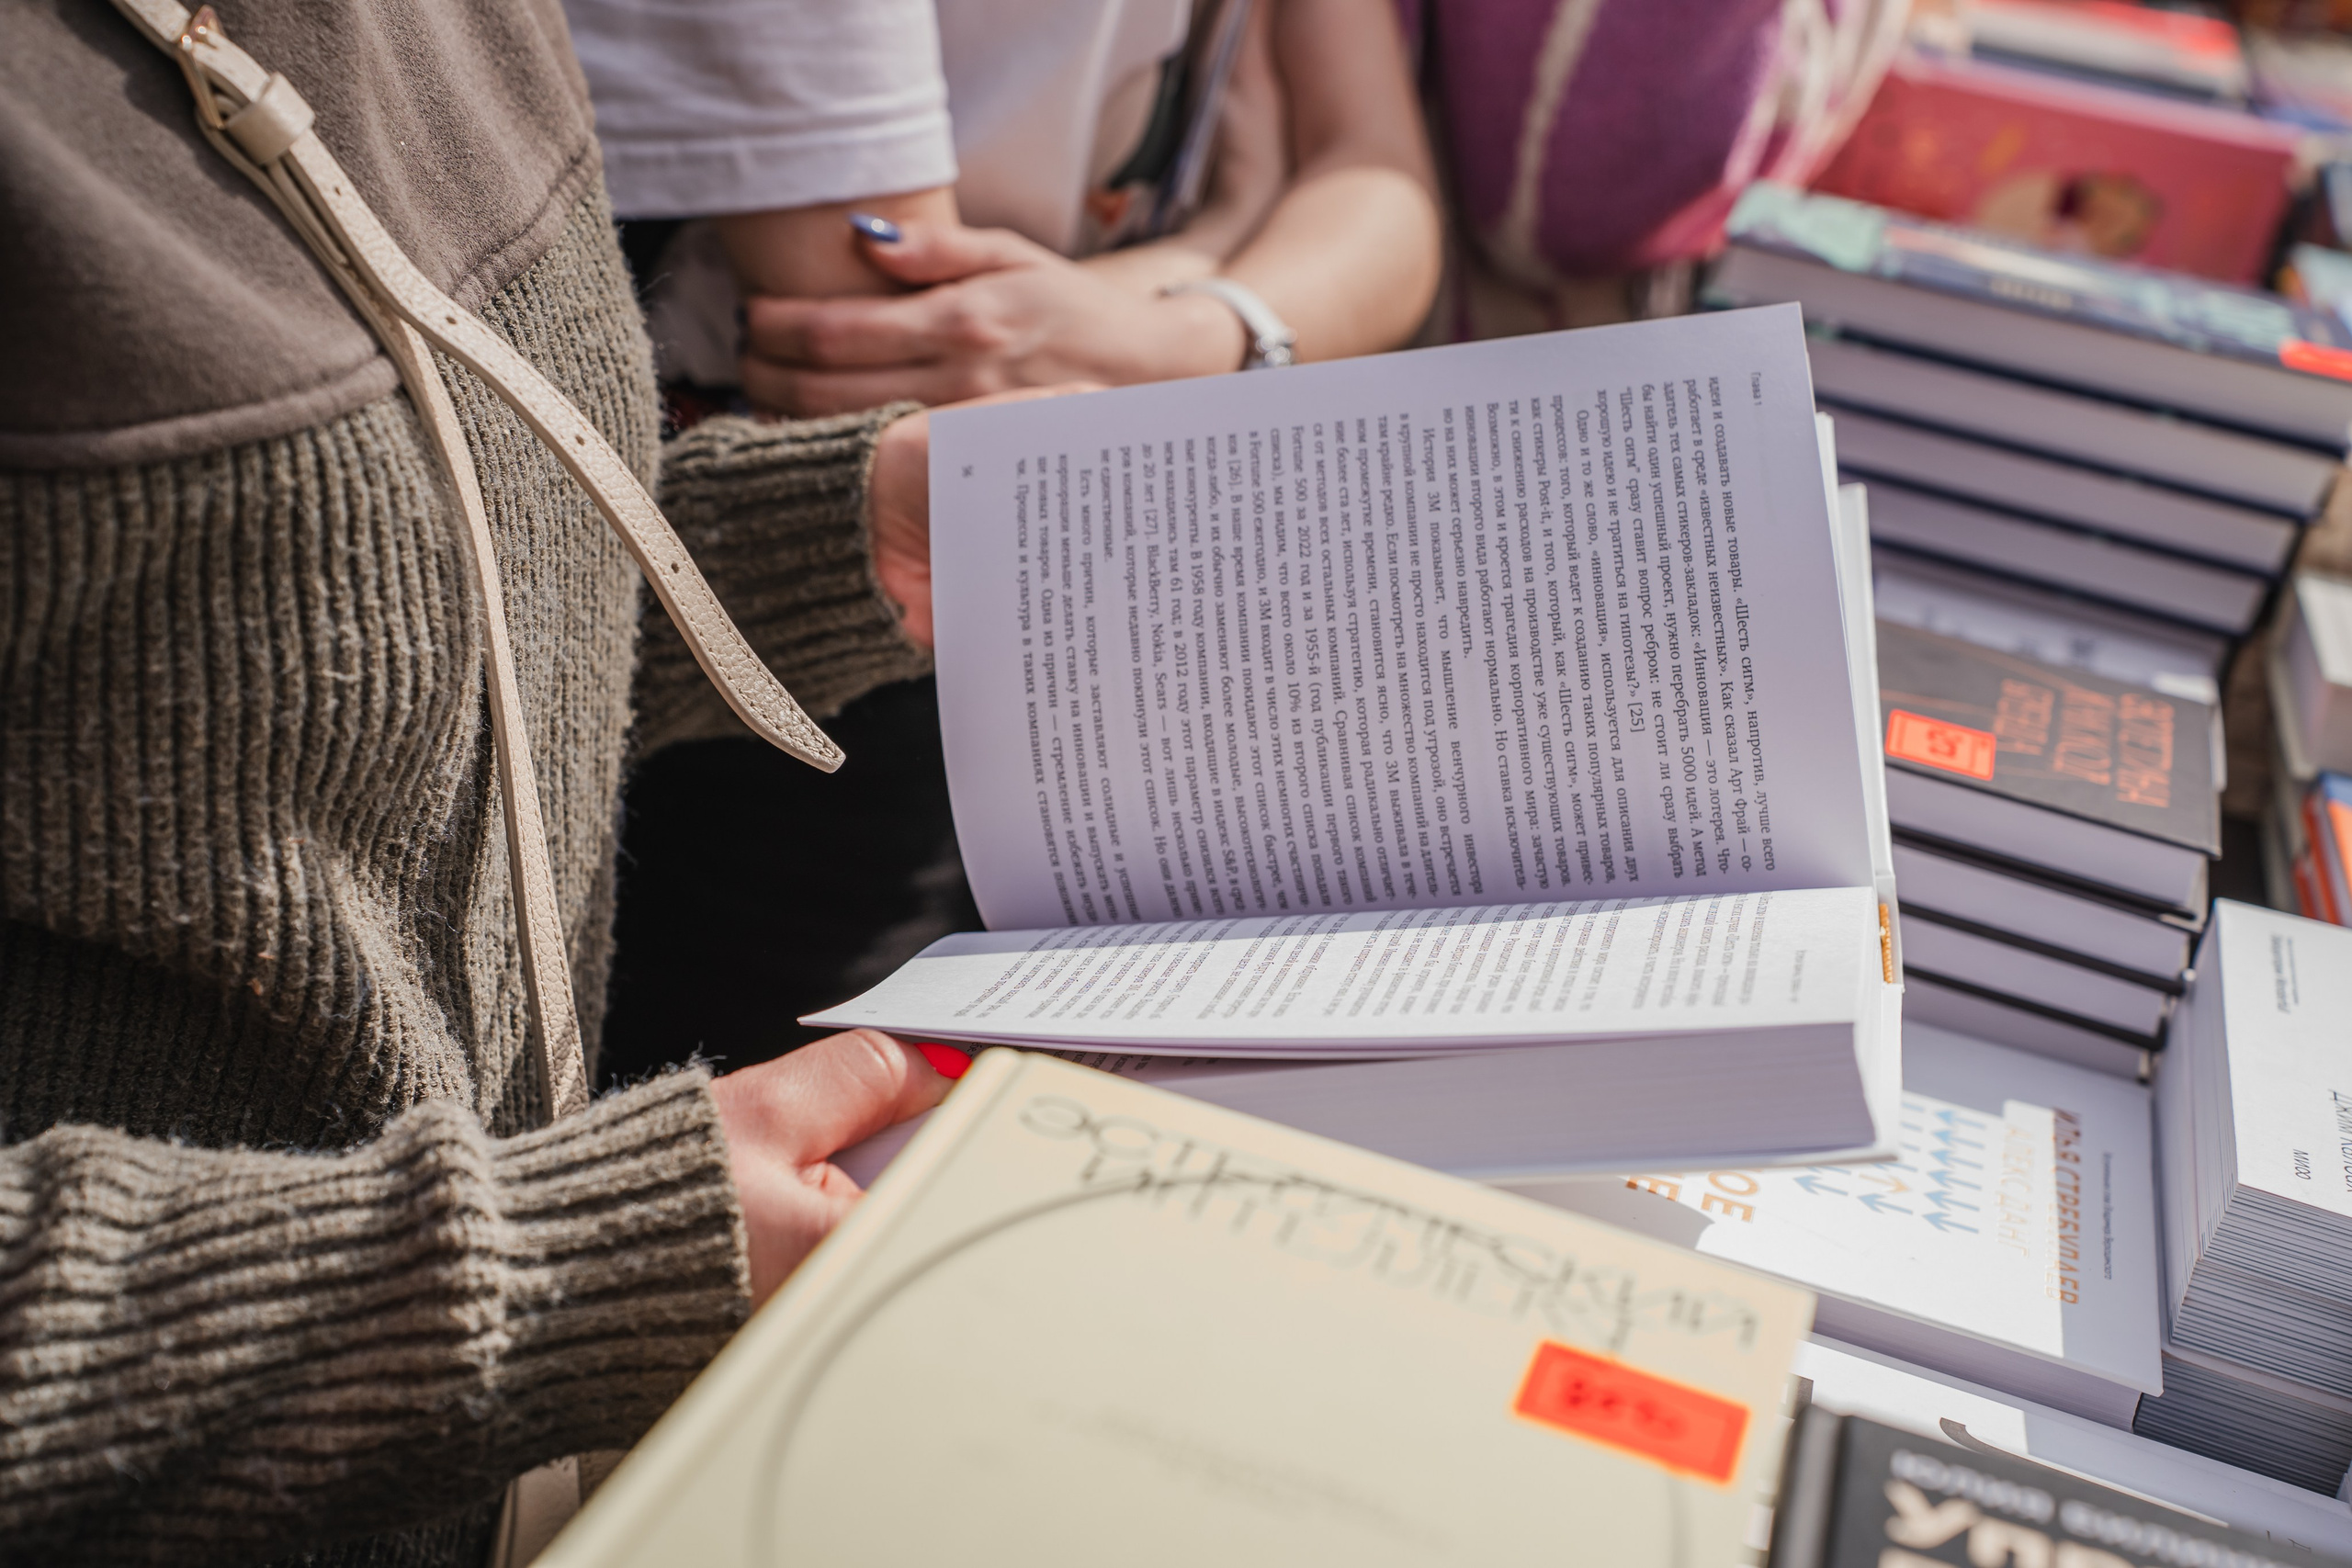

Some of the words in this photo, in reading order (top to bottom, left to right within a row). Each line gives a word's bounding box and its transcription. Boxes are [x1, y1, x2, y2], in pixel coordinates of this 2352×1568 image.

[1708, 376, 1722, 407] идеи
[1750, 371, 1761, 400] Глава
[1643, 404, 1659, 444] найти
[1713, 411, 1724, 420] и
[1646, 446, 1661, 479] один
[1668, 431, 1681, 454] тех
[1692, 438, 1703, 447] в
[1713, 423, 1731, 487] создавать
[1558, 466, 1572, 500] того,
[1581, 460, 1592, 476] то
[1583, 479, 1595, 498] же
[1602, 450, 1616, 485] идею
[1671, 456, 1686, 498] самых
[1690, 449, 1708, 486] среде
[1447, 472, 1462, 513] может
[1468, 479, 1485, 532] второго
[1493, 487, 1506, 518] этом
[1537, 479, 1555, 525] Post-it,
[1606, 488, 1617, 497] и
[1608, 500, 1620, 517] не
[1625, 478, 1642, 513] сразу
[1722, 491, 1736, 534] новые
[1497, 522, 1508, 532] и
[1513, 502, 1532, 563] расходов
[1542, 528, 1553, 537] и
[1561, 502, 1581, 561] который
[1585, 502, 1599, 546] слово,
[1648, 481, 1672, 552] успешный
[1699, 489, 1717, 568] «известных
[1449, 516, 1466, 578] серьезно
[1475, 534, 1487, 566] вида
[1495, 536, 1512, 590] кроется
[1544, 541, 1556, 576] того,
[1606, 519, 1626, 589] тратиться
[1632, 518, 1647, 564] ставит
[1320, 548, 1336, 622] остальных
[1522, 566, 1534, 583] на
[1567, 564, 1582, 603] ведет
[1657, 555, 1675, 608] проект,
[1677, 501, 1702, 637] стикеров-закладок:
[1726, 536, 1743, 592] товары.
[1475, 568, 1495, 637] работают
[1546, 580, 1566, 647] который,
[1572, 606, 1583, 615] к
[1590, 550, 1609, 647] «инновация»,
[1617, 592, 1629, 609] на
[1636, 569, 1653, 619] вопрос
[1236, 592, 1251, 663] компании
[1369, 599, 1385, 680] становится
[1437, 614, 1449, 639] что
[1455, 581, 1473, 659] навредить.
[1500, 593, 1519, 659] трагедия
[1522, 588, 1545, 687] производстве
[1663, 612, 1680, 660] нужно
[1707, 570, 1728, 677] неизвестных».
[1735, 597, 1750, 652] «Шесть
[1173, 643, 1190, 678] 2012
[1260, 624, 1274, 672] входит
[1283, 633, 1296, 676] около
[1304, 627, 1321, 675] 1955-й
[1327, 626, 1346, 705] компаний.
[1415, 621, 1432, 695] находится
[1554, 650, 1566, 677] как
[1574, 618, 1591, 691] созданию
[1619, 613, 1641, 697] гипотезы?»
[1640, 624, 1660, 683] ребром:
[1194, 632, 1211, 710] компании,
[1345, 612, 1364, 693] стратегию,
[1355, 696, 1372, 756] которая
[1440, 649, 1458, 730] мышление
[1483, 639, 1503, 727] нормально.
[1692, 641, 1713, 735] «Инновация
[1741, 656, 1755, 705] сигм»,
[1220, 675, 1235, 717] более
[1241, 667, 1259, 740] покидают
[1266, 686, 1280, 730] число
[1287, 682, 1302, 713] 10%
[1307, 682, 1323, 714] (год
[1376, 685, 1390, 724] ясно,
[1388, 567, 1405, 649] посмотреть
[1397, 671, 1416, 754] множество
[1407, 757, 1430, 829] компаний
[1422, 699, 1436, 728] под
[1532, 691, 1549, 720] уже
[1558, 681, 1573, 737] «Шесть
[1582, 694, 1597, 739] таких
[1600, 652, 1622, 751] используется
[1626, 702, 1645, 733] [25]
[1651, 690, 1663, 708] не
[1669, 663, 1690, 742] перебрать
[1720, 681, 1735, 710] Как
[1180, 719, 1194, 750] этот
[1382, 729, 1394, 755] что
[1494, 729, 1509, 751] Но
[1508, 663, 1533, 785] корпоративного
[1654, 714, 1668, 757] стоит
[1724, 714, 1739, 763] сказал
[1250, 745, 1263, 777] этот
[1270, 733, 1283, 767] этих
[1293, 740, 1310, 799] второго
[1310, 718, 1334, 807] публикации
[1331, 709, 1354, 790] Сравнивая
[1564, 740, 1578, 788] сигм»,
[1610, 756, 1625, 783] для
[1658, 761, 1671, 780] ли
[1680, 746, 1698, 783] 5000
[1746, 710, 1765, 786] напротив,
[1450, 740, 1471, 825] венчурного
[1497, 754, 1513, 803] ставка
[1536, 724, 1563, 833] существующих
[1587, 742, 1608, 829] популярных
[1705, 760, 1718, 784] это
[1727, 768, 1744, 795] Арт
[1435, 795, 1448, 822] оно
[1523, 790, 1540, 830] мира:
[1570, 793, 1587, 837] может
[1616, 787, 1634, 852] описания
[1659, 785, 1677, 823] сразу
[1685, 786, 1702, 824] идей.
[1709, 787, 1725, 845] лотерея.
[1731, 798, 1751, 834] Фрай
[1753, 790, 1771, 834] лучше
[1504, 806, 1527, 891] исключитель-
[1667, 827, 1684, 879] выбрать
[1690, 828, 1704, 839] А
[1761, 838, 1776, 872] всего
[1531, 835, 1550, 890] зачастую
[1554, 836, 1572, 887] товаров.
[1575, 840, 1594, 886] привес-
[1599, 831, 1616, 884] товаров,
[1623, 855, 1639, 883] двух
[1692, 840, 1707, 877] метод
[1716, 848, 1731, 874] Что-
[1740, 854, 1752, 873] со-
[2052, 1107, 2082, 1163] ИЛЬЯ
[1995, 1190, 2031, 1258] ДАНГ
[2044, 1165, 2080, 1304] СТРЕБУЛАЕВ
